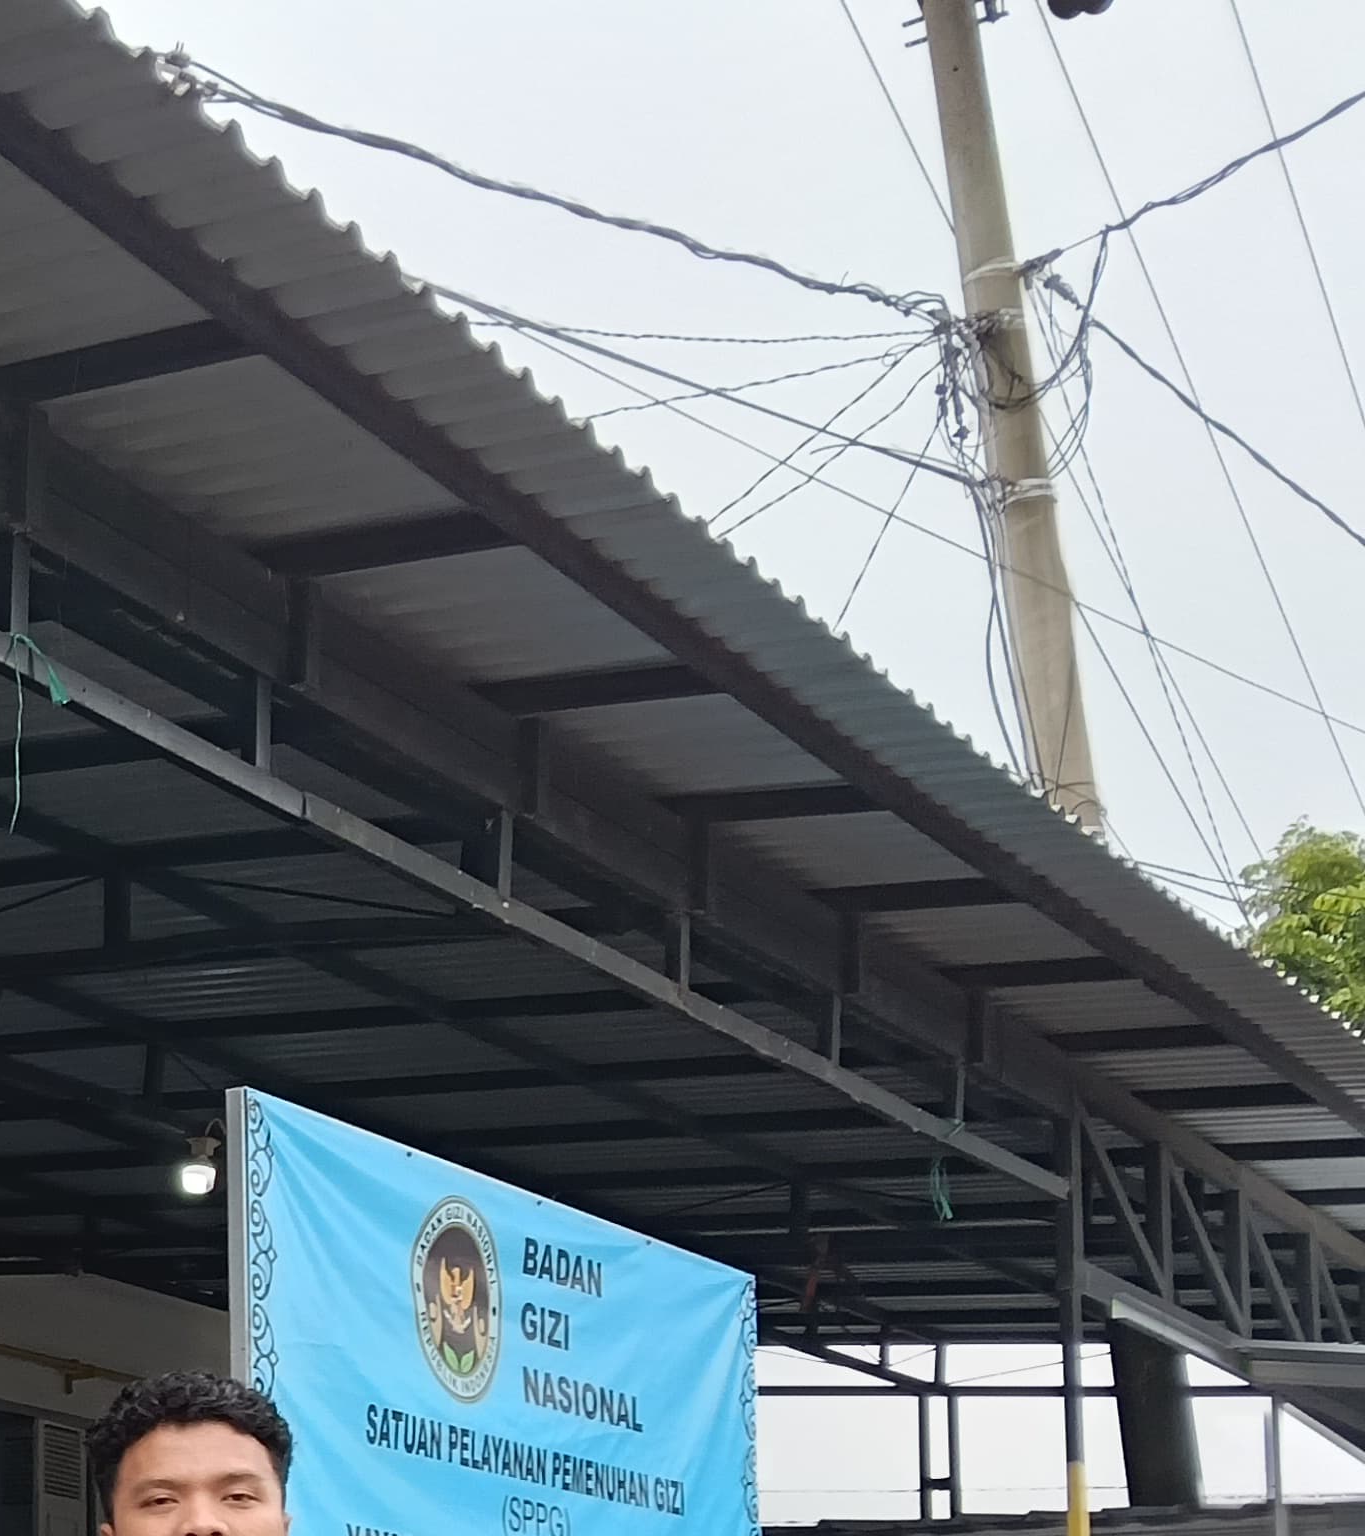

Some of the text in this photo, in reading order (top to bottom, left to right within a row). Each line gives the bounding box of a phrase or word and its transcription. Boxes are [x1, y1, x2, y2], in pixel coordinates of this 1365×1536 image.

[520, 1237, 604, 1299] BADAN
[520, 1302, 570, 1352] GIZI
[522, 1366, 644, 1433] NASIONAL
[366, 1403, 685, 1516] SATUAN PELAYANAN PEMENUHAN GIZI
